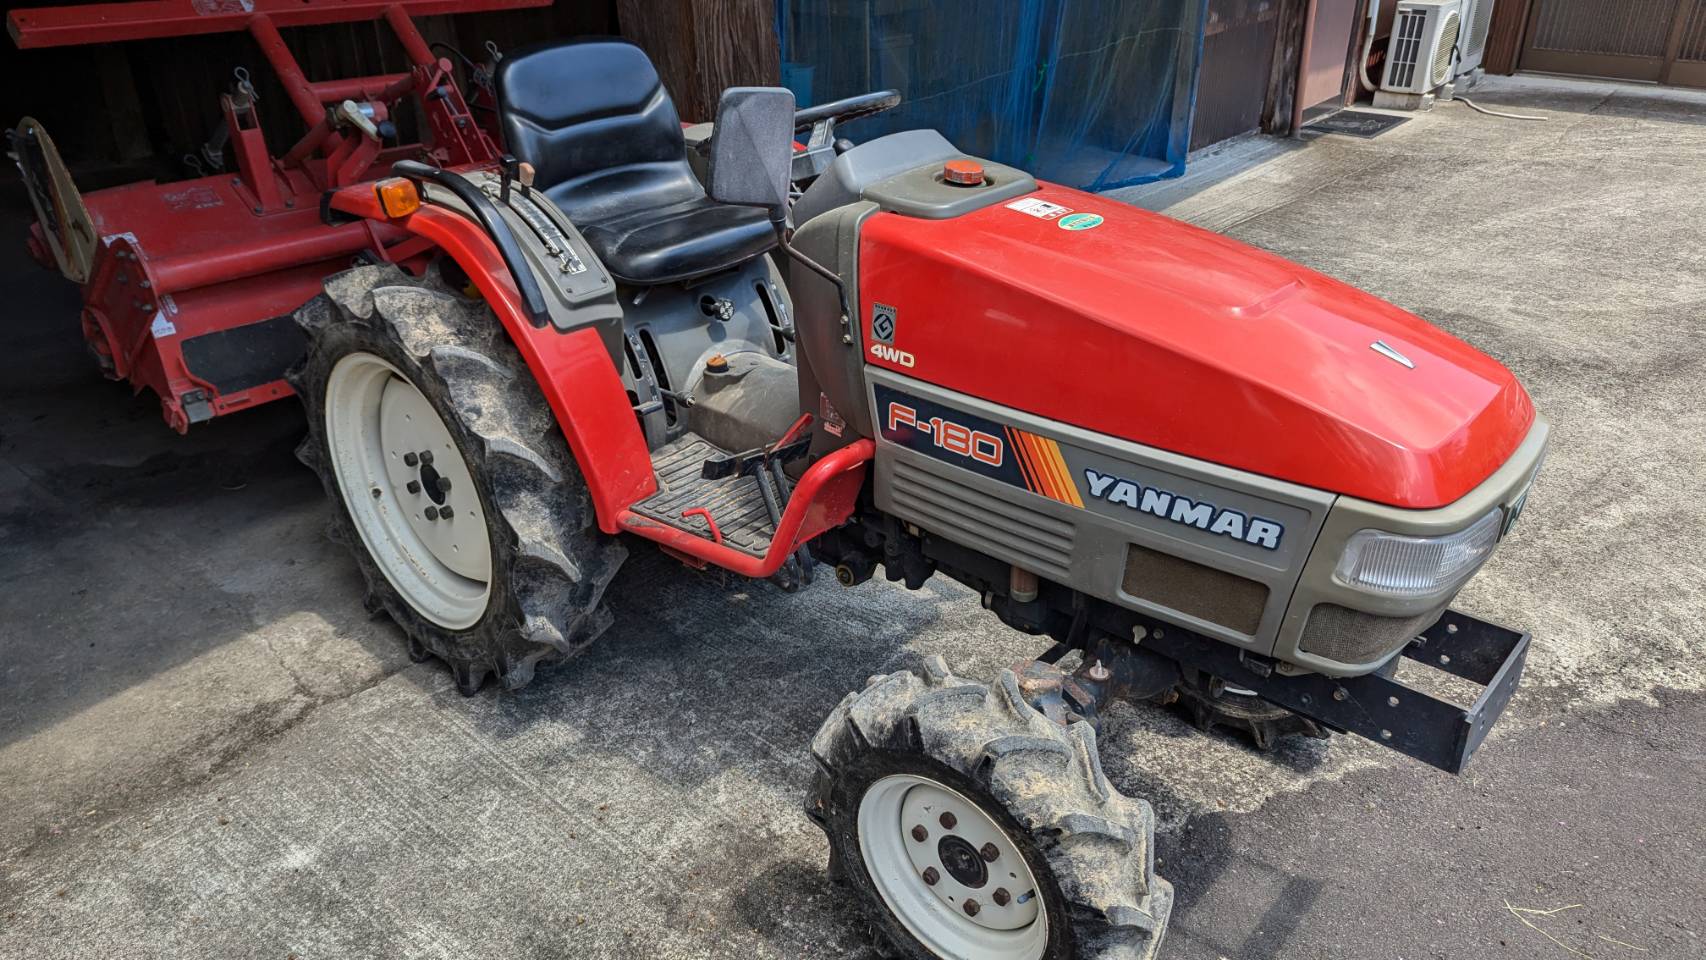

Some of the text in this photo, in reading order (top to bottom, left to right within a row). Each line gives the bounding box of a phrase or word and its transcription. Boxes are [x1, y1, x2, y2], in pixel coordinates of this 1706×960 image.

[870, 343, 915, 368] 4WD
[888, 401, 1004, 467] F-180
[1084, 468, 1284, 550] YANMAR
